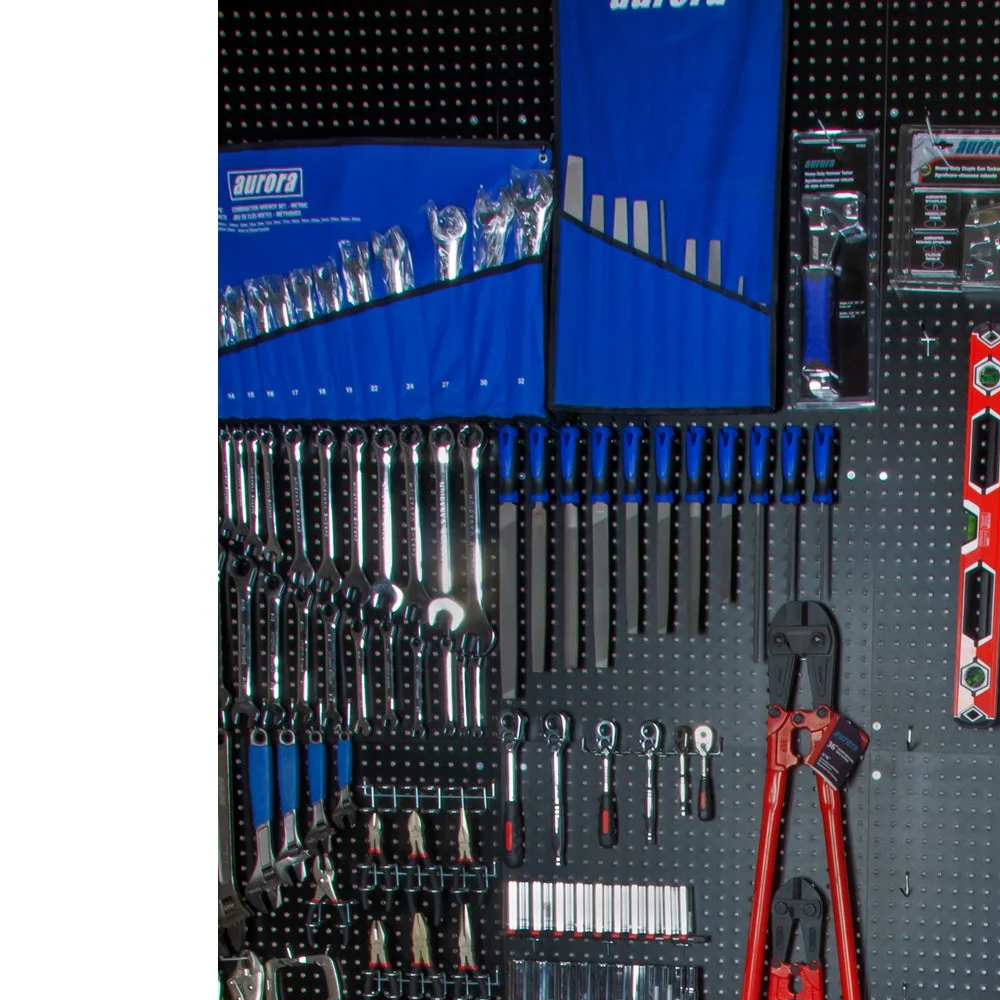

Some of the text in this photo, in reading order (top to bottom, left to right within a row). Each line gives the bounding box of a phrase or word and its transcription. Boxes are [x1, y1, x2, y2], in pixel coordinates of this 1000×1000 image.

[233, 172, 298, 196] aurora
[406, 382, 414, 390] 24
[517, 377, 525, 385] 32
